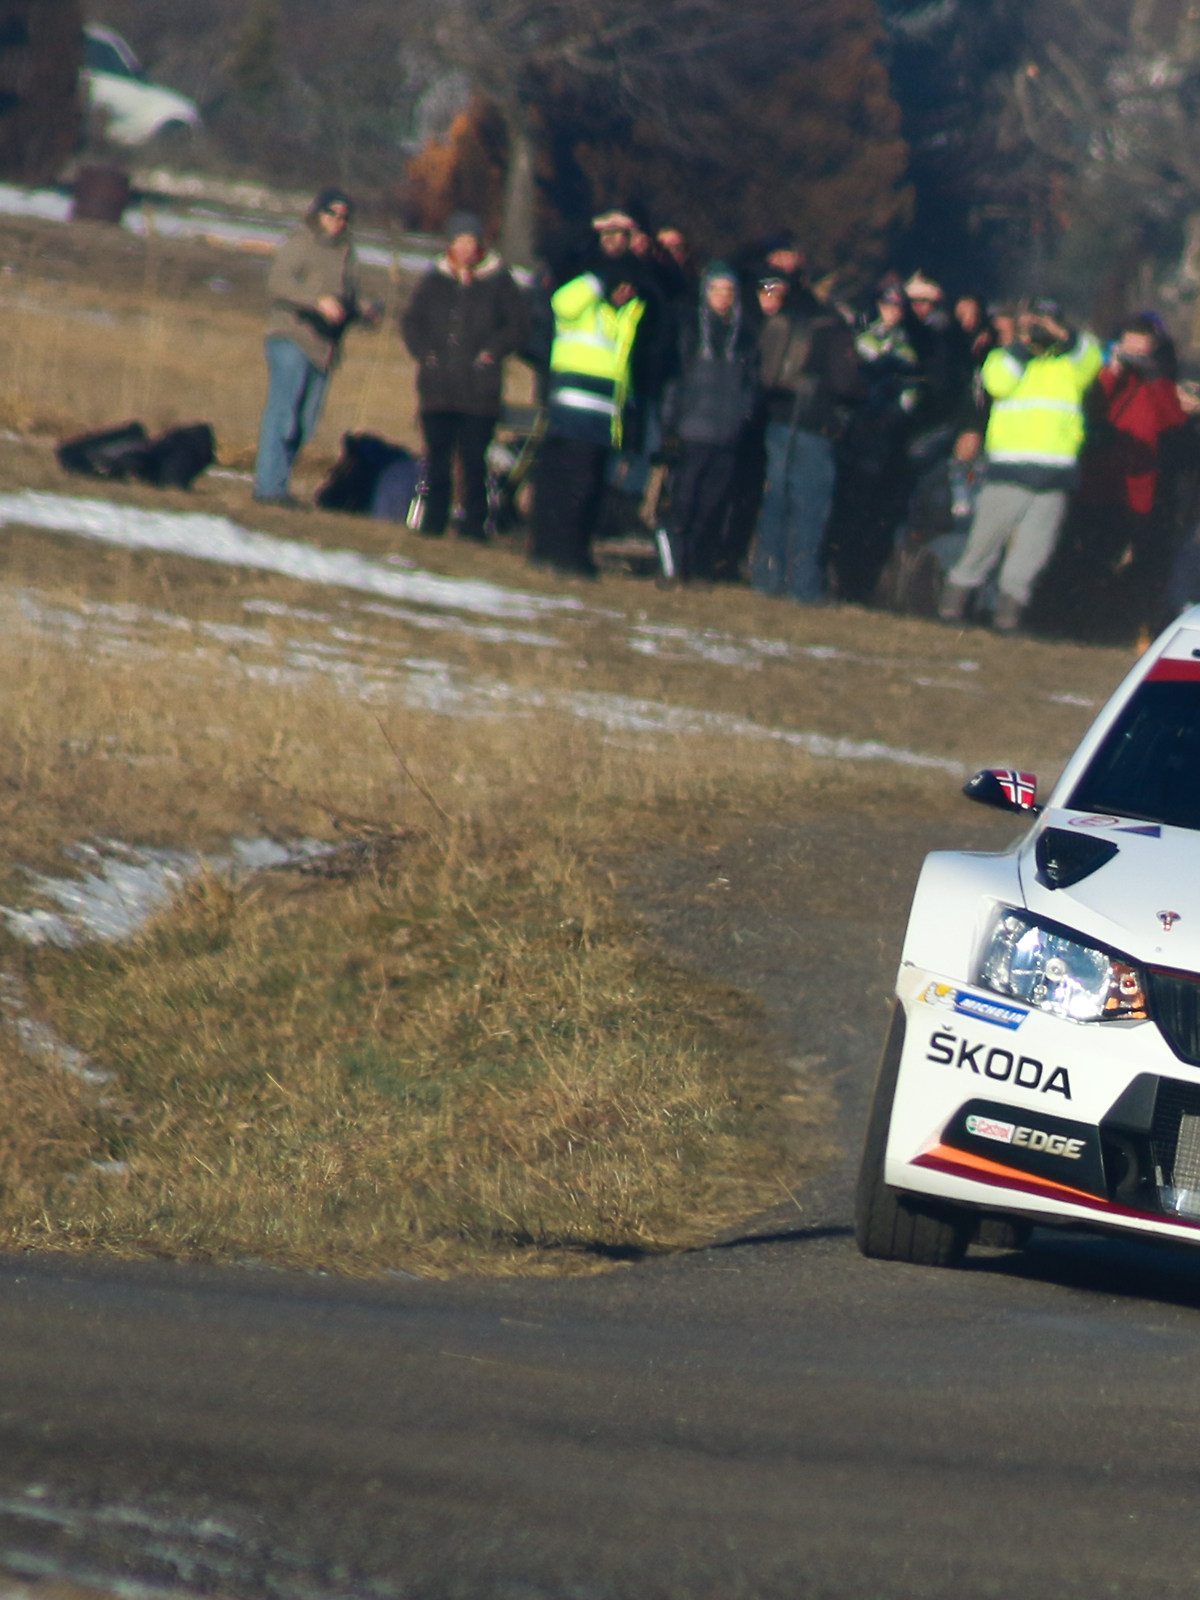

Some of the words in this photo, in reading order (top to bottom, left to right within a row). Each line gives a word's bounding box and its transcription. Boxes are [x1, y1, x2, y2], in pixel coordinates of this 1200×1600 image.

[959, 998, 1027, 1023] MICHELIN
[926, 1025, 1073, 1101] ŠKODA
[1011, 1126, 1087, 1160] EDGE
